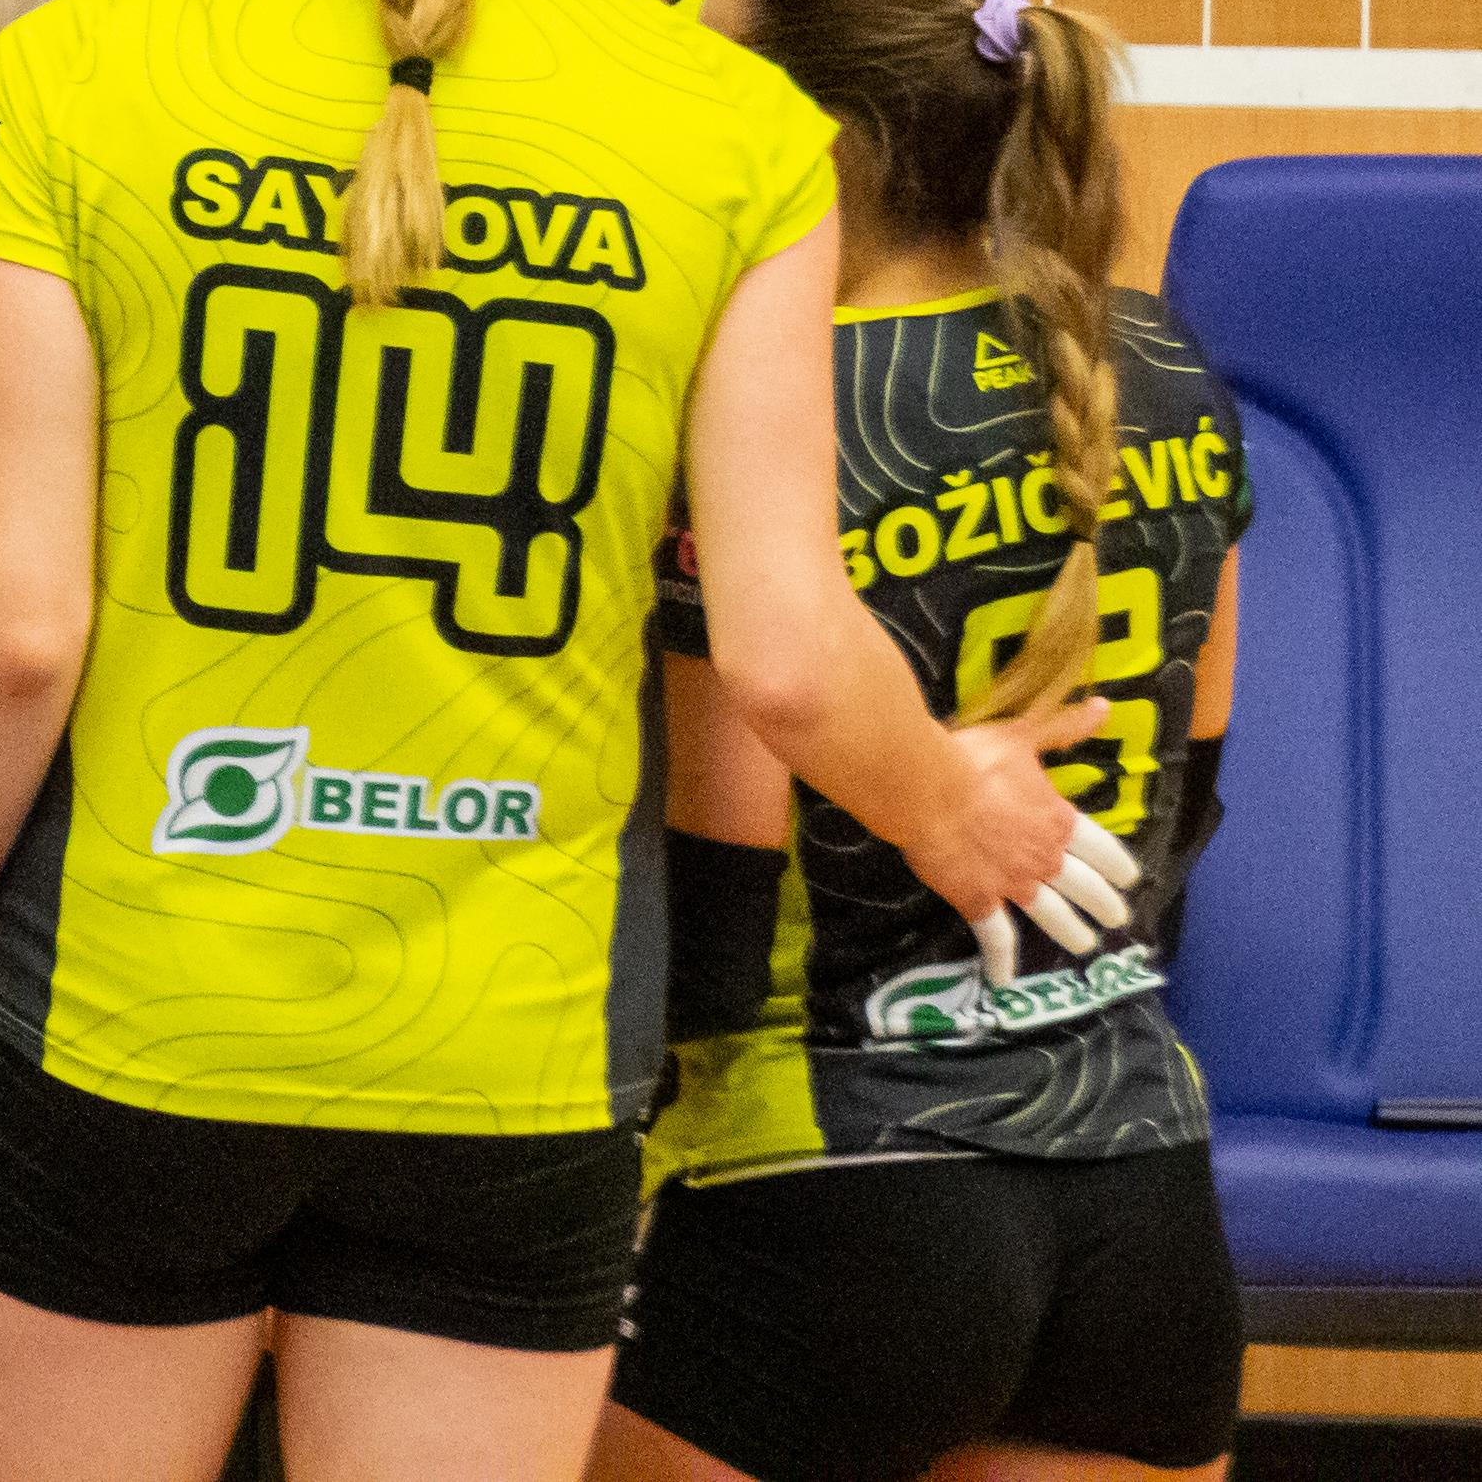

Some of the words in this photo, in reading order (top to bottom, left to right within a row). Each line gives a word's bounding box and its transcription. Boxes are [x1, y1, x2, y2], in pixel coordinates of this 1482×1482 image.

[171, 149, 645, 291] SAYOVA
[165, 263, 616, 657] 14
[310, 778, 535, 837] BELOR
